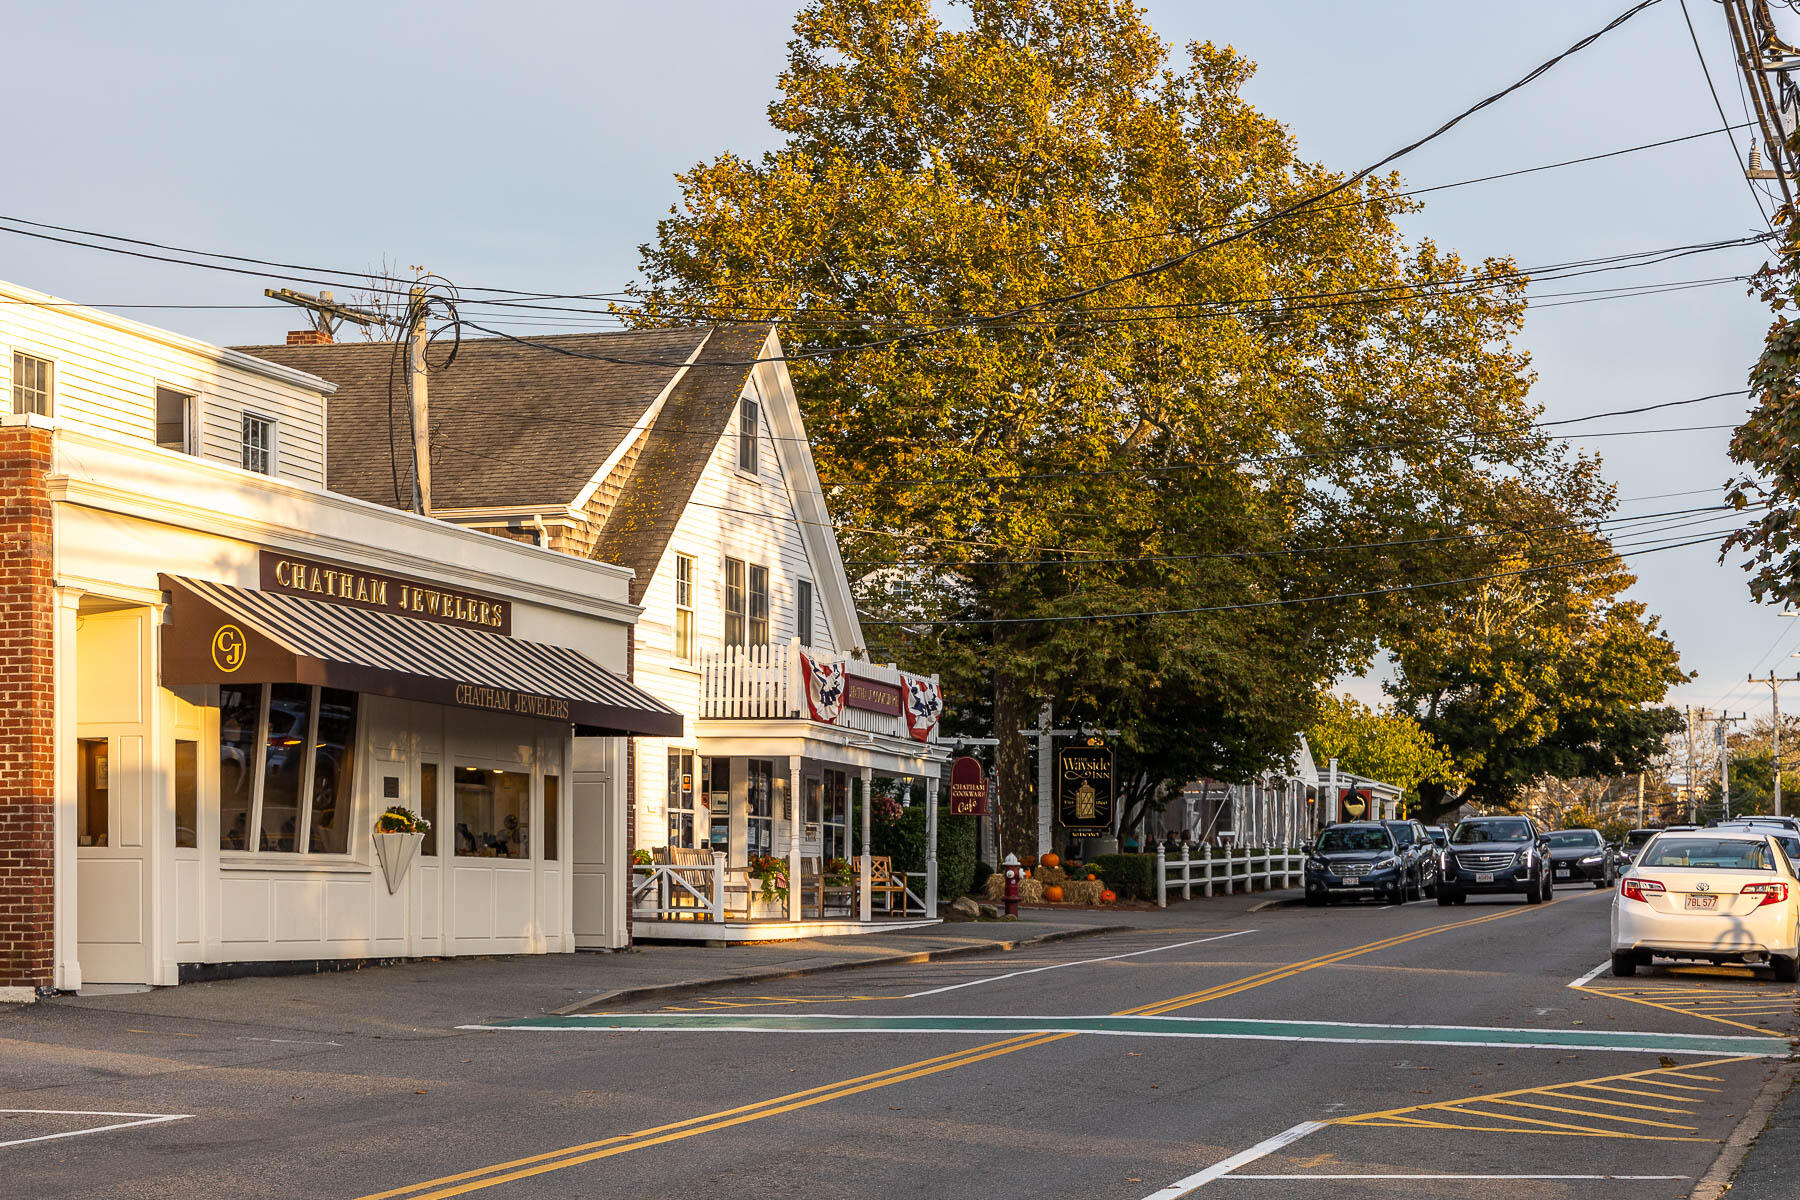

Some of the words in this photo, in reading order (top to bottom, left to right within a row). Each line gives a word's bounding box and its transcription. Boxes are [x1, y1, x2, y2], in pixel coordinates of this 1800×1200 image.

[276, 560, 388, 606] CHATHAM
[399, 584, 503, 628] JEWELERS
[455, 684, 511, 711] CHATHAM
[514, 693, 569, 720] JEWELERS
[1063, 757, 1111, 772] Wayside
[1092, 770, 1111, 779] INN
[952, 783, 985, 791] CHATHAM
[952, 790, 986, 798] COOKWARE
[1687, 897, 1701, 907] 7BL
[1702, 898, 1717, 908] 577
